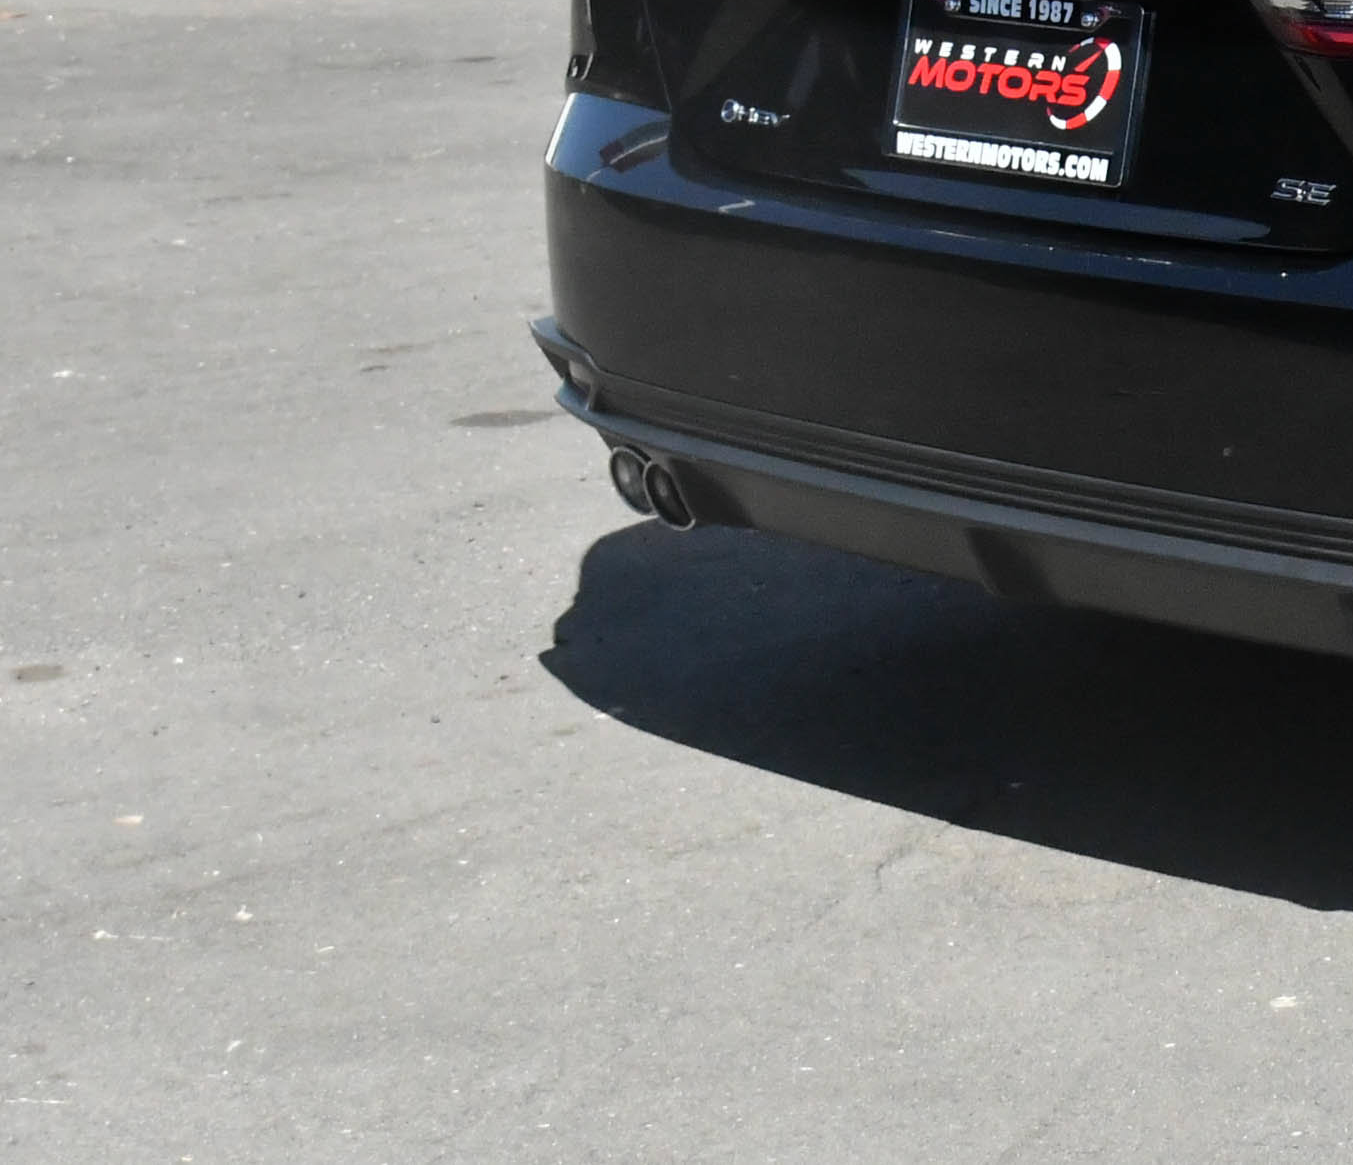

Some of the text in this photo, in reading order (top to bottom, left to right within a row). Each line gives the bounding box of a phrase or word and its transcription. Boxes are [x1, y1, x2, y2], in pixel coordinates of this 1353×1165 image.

[914, 38, 1067, 72] WESTERN
[908, 54, 1090, 107] MOTORS
[896, 131, 1110, 182] WESTERNMOTORS.COM
[1270, 178, 1337, 206] SE
